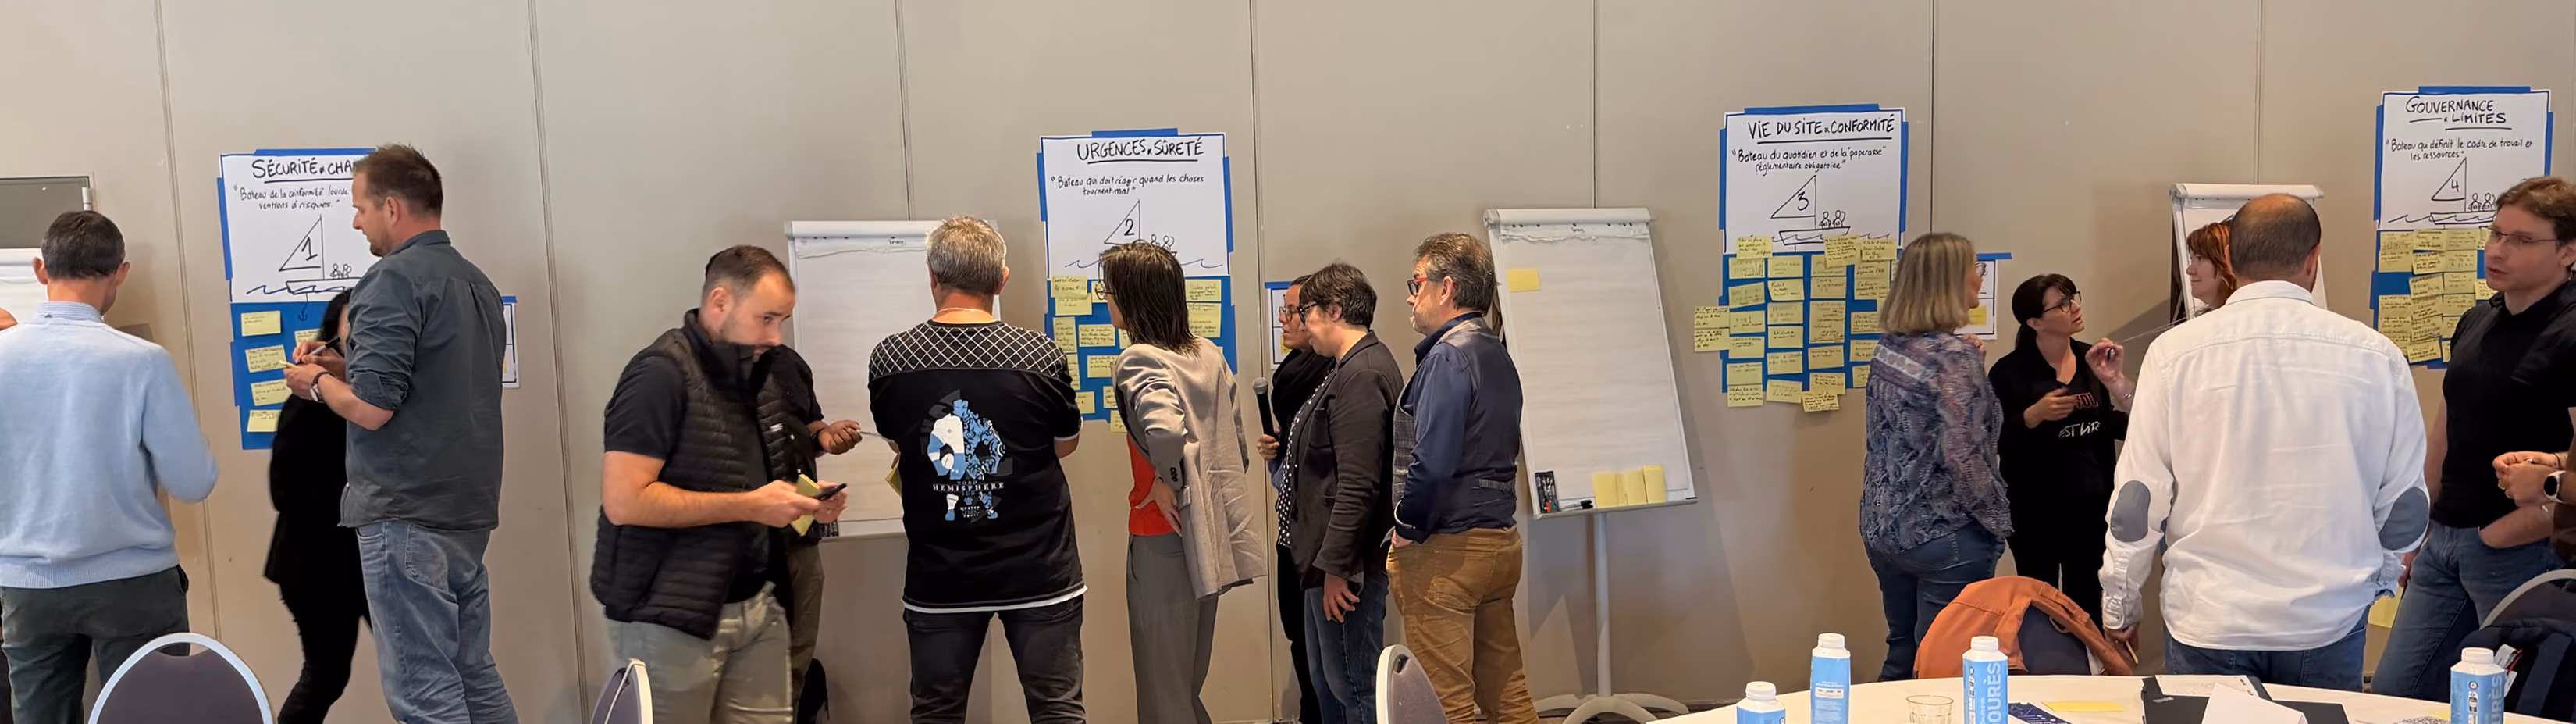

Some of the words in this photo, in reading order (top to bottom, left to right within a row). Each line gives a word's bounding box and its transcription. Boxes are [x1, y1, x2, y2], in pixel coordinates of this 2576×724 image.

[2405, 95, 2494, 114] GOUVERNANCE
[1777, 121, 1791, 134] DU
[1076, 138, 1146, 161] URGENCES
[1154, 136, 1204, 156] SÛRETÉ
[2429, 137, 2453, 149] définit
[2457, 137, 2464, 148] le
[2466, 138, 2488, 148] cadre
[2489, 139, 2497, 148] de
[2500, 137, 2523, 148] travail
[1770, 149, 1781, 160] du
[1782, 148, 1817, 160] quotidien
[1820, 148, 1829, 158] et
[1830, 148, 1839, 157] de
[1840, 148, 1847, 157] la
[2410, 152, 2421, 161] les
[327, 159, 354, 175] CHA
[1086, 177, 1098, 187] qui
[1099, 176, 1115, 186] doit
[1139, 174, 1164, 188] quand
[1179, 173, 1204, 184] choses
[2451, 178, 2460, 193] 4
[269, 188, 279, 200] de
[279, 187, 287, 199] la
[288, 187, 325, 199] conformité
[1796, 191, 1809, 211] 3
[1123, 218, 1135, 237] 2
[301, 236, 318, 262] 1
[1983, 662, 2001, 724] OURÈS
[2488, 675, 2503, 724] URÈS
